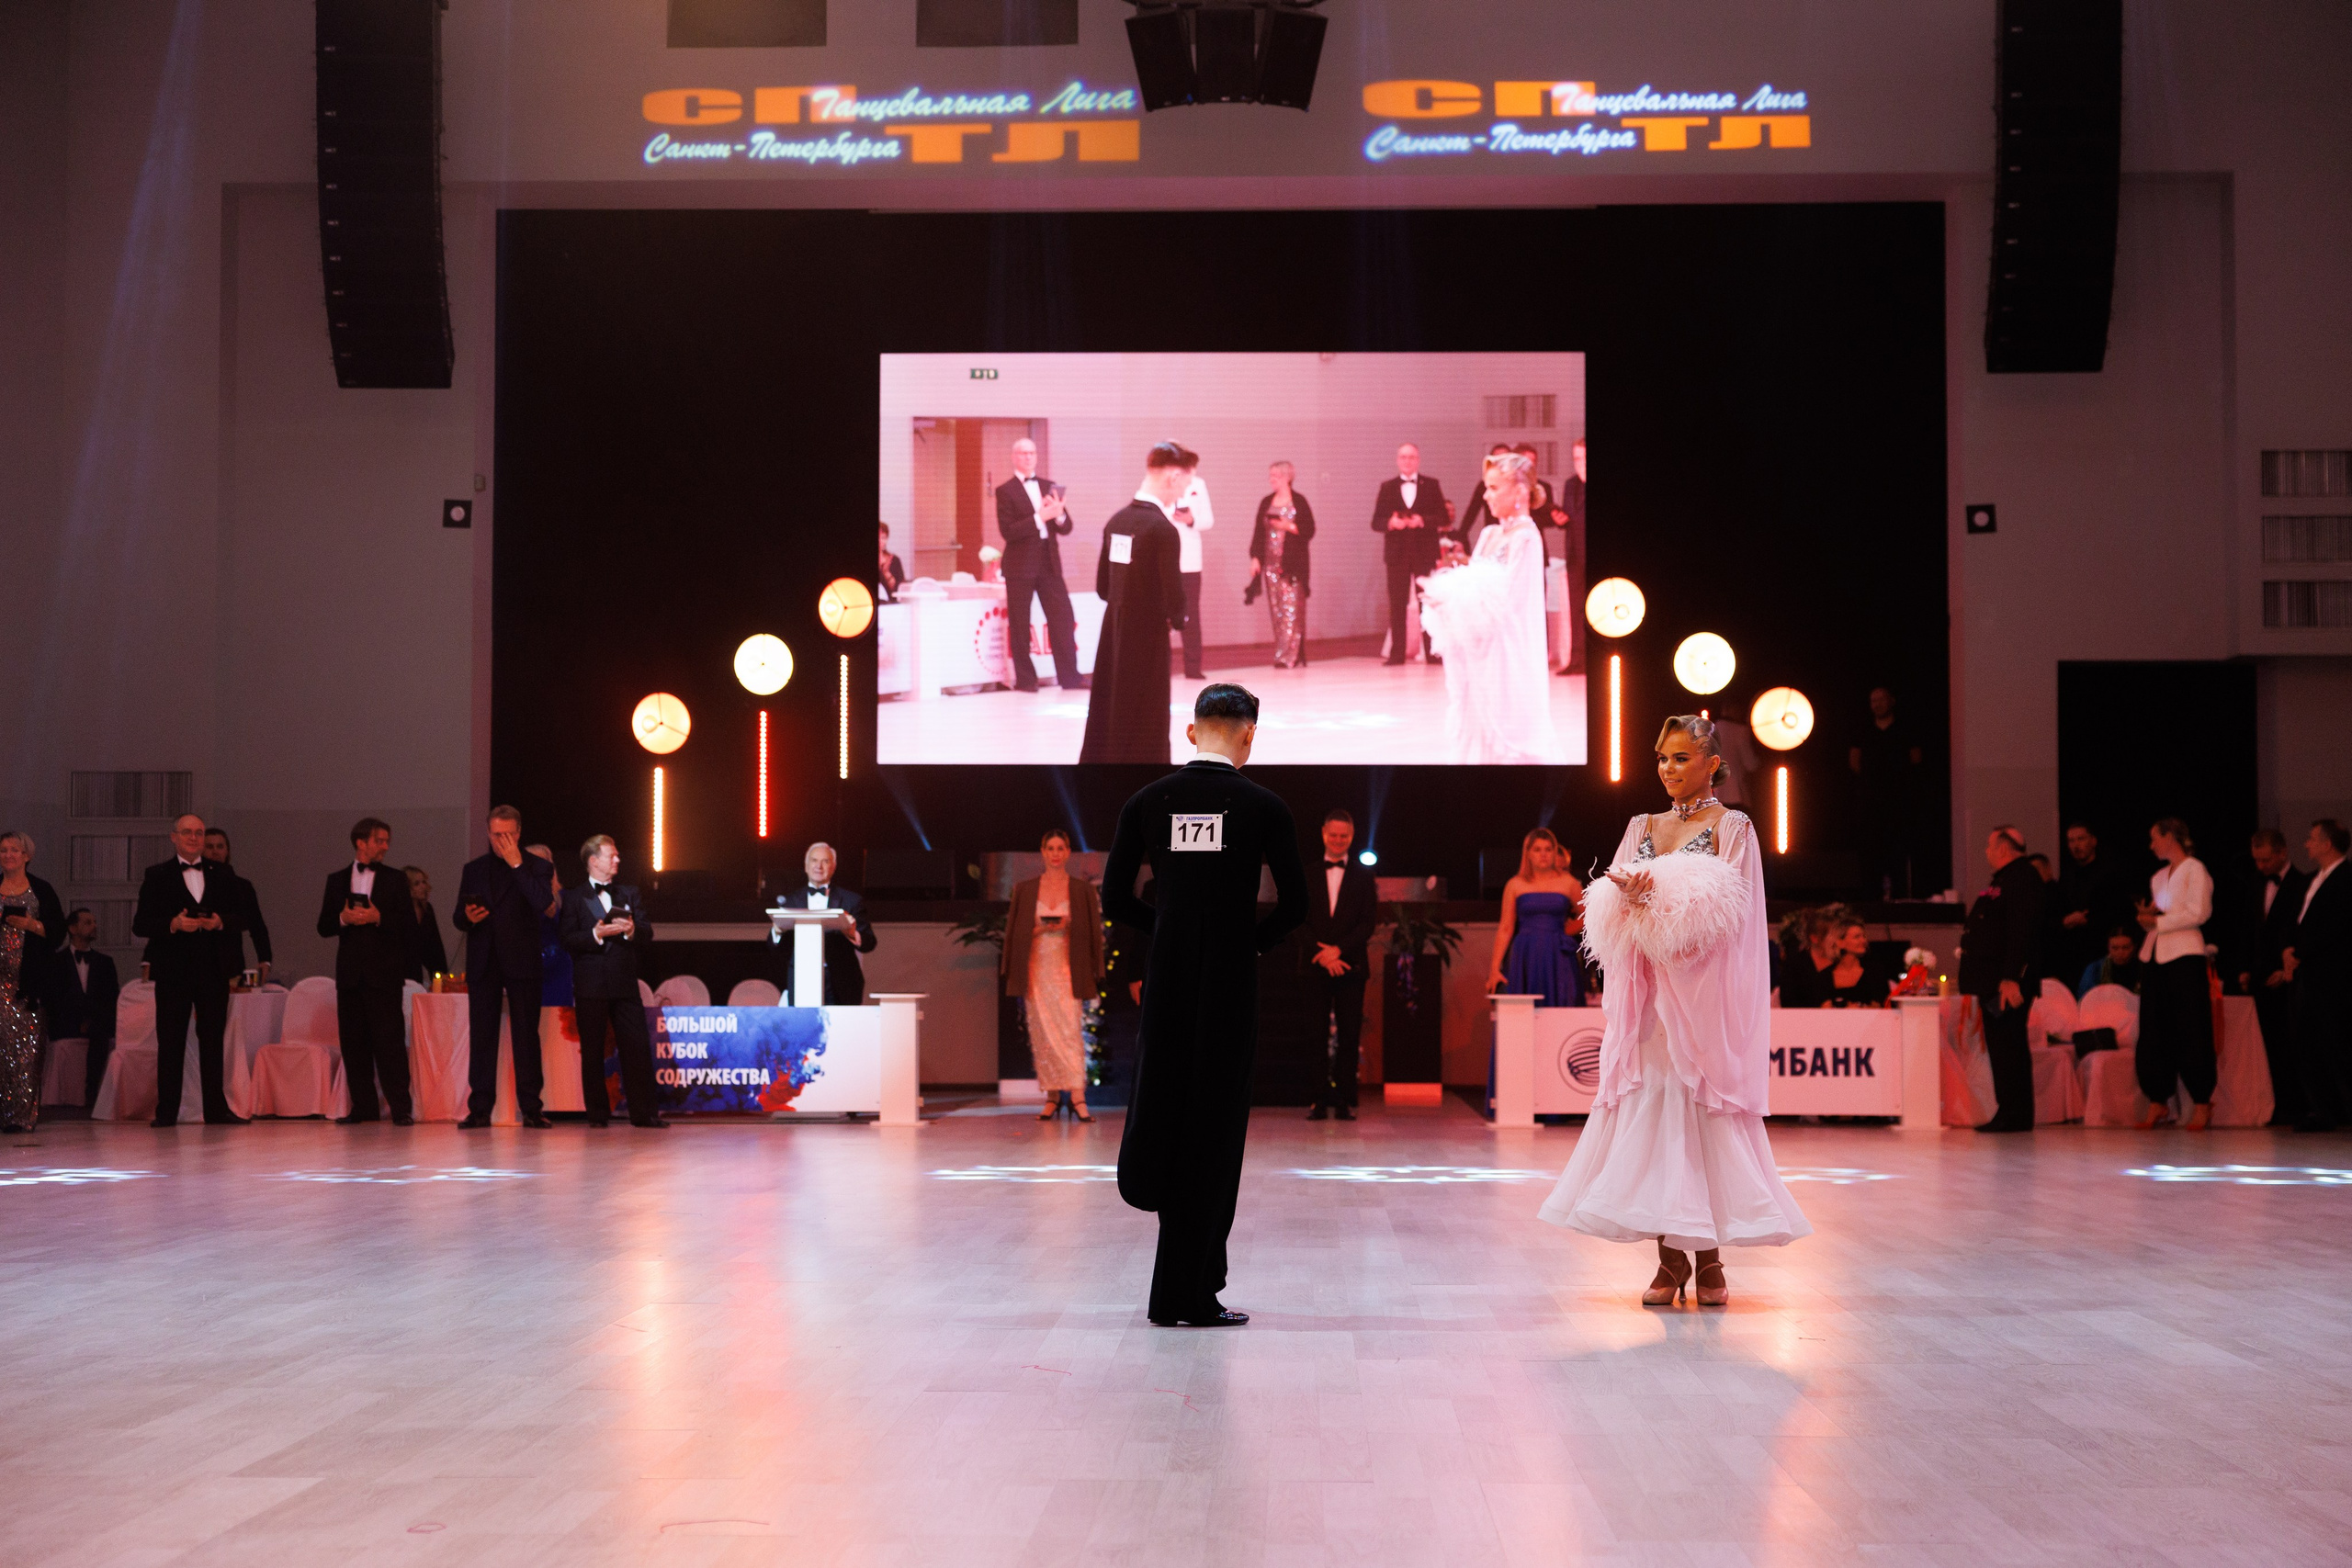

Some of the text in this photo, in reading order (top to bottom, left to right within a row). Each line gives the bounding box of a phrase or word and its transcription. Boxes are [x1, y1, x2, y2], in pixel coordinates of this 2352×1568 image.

[642, 85, 857, 125] СП
[810, 81, 1136, 121] Танцевальная Лига
[1363, 80, 1596, 118] СП
[1551, 85, 1808, 115] Танцевальная Лига
[643, 131, 902, 164] Санкт-Петербурга
[884, 119, 1141, 164] ТЛ
[1365, 123, 1637, 161] Санкт-Петербурга
[1621, 115, 1812, 152] ТЛ
[1178, 822, 1215, 842] 171
[656, 1013, 738, 1033] БОЛЬШОЙ
[656, 1043, 708, 1059] КУБОК
[655, 1067, 771, 1088] СОДРУЖЕСТВА
